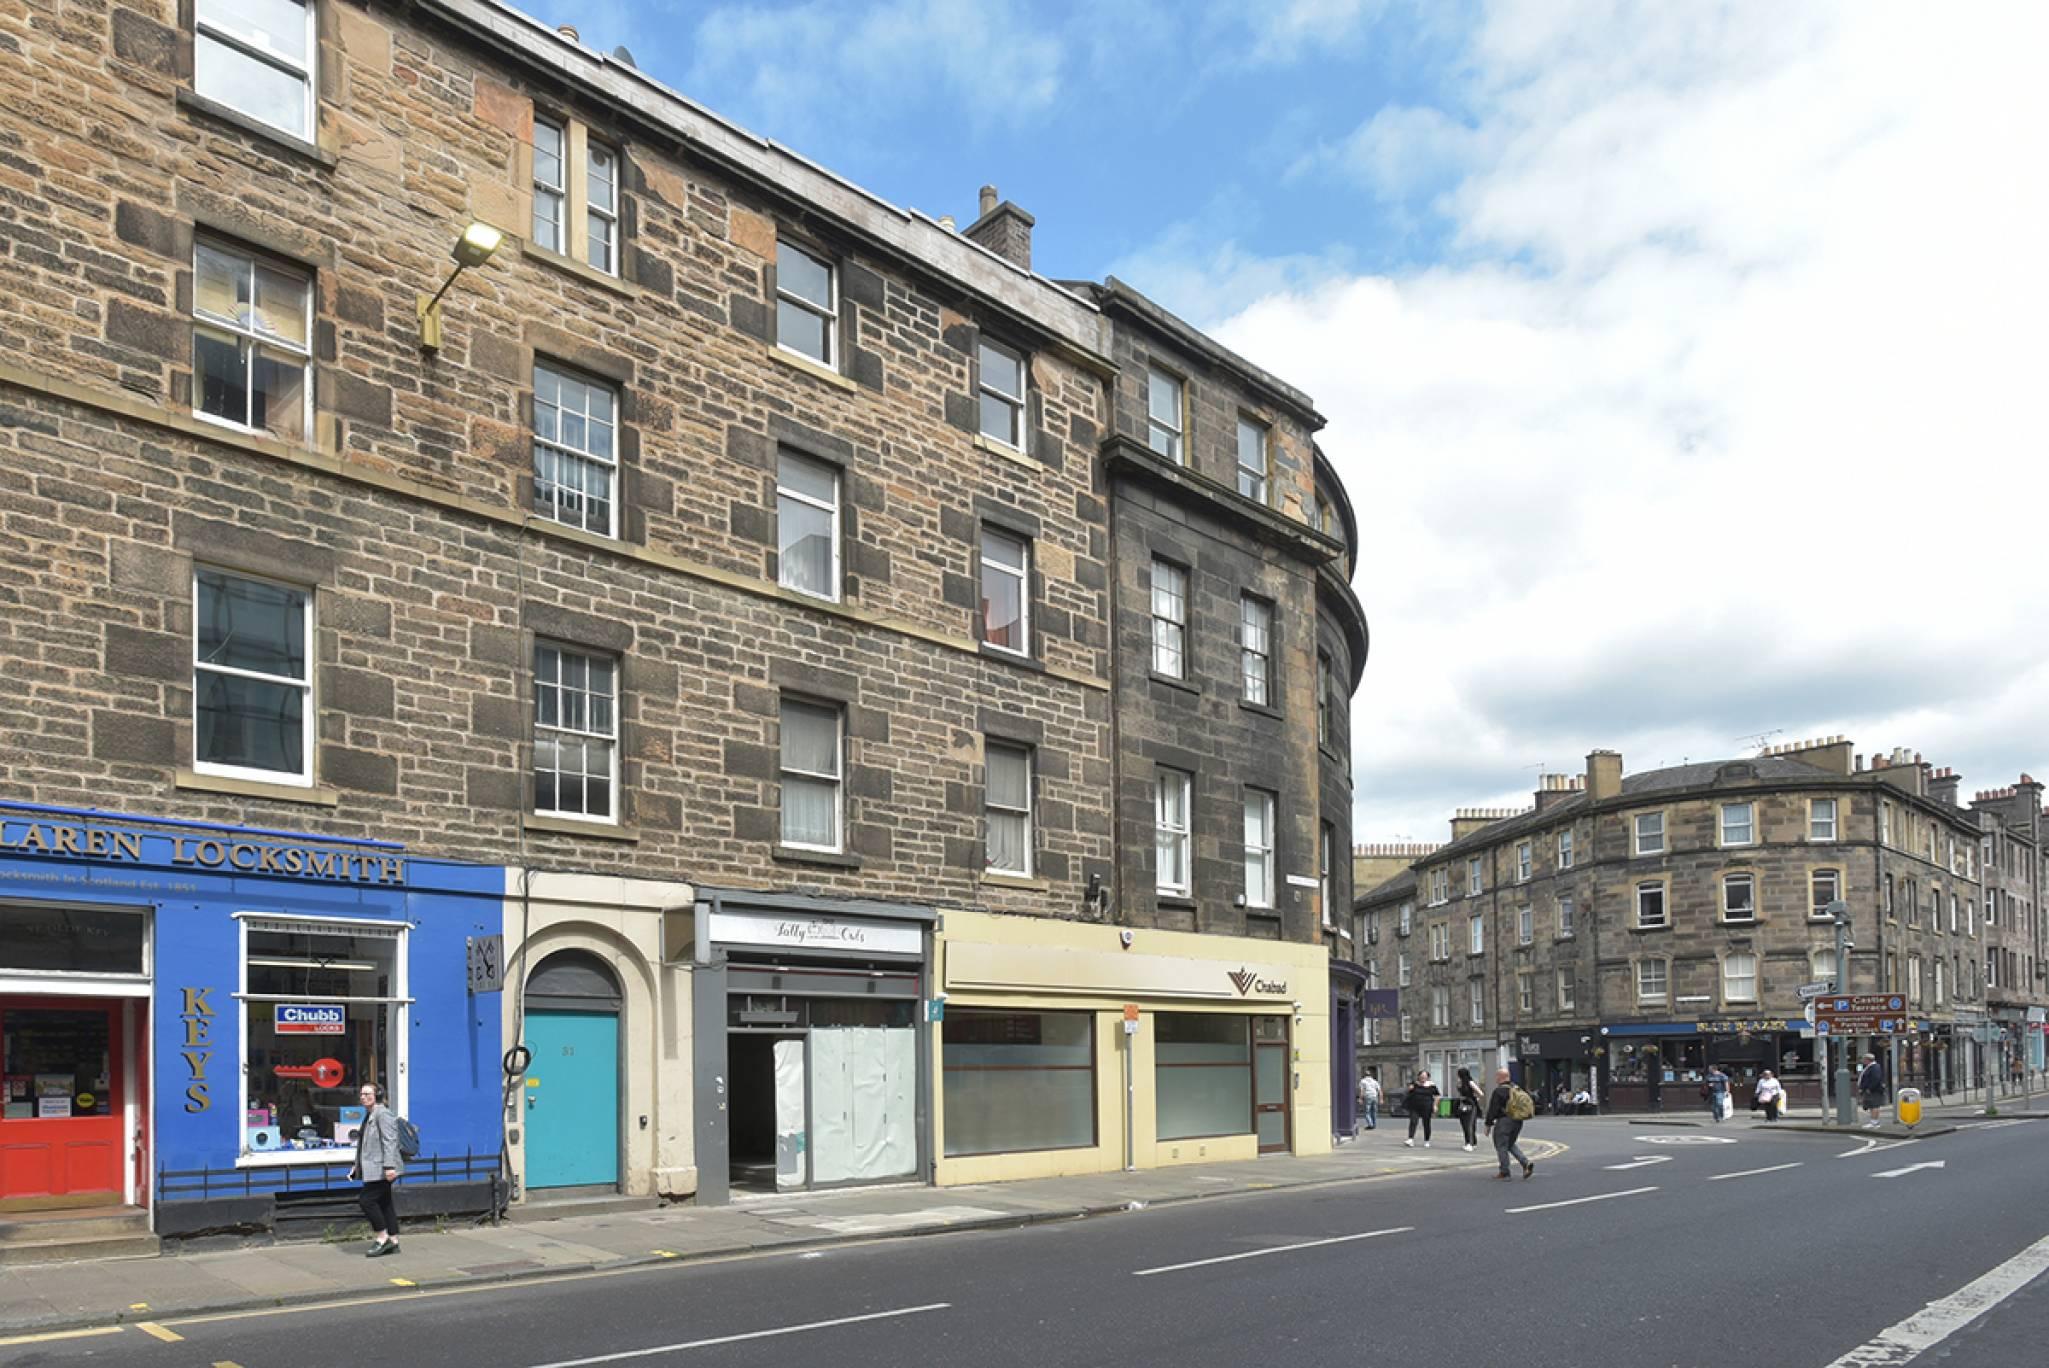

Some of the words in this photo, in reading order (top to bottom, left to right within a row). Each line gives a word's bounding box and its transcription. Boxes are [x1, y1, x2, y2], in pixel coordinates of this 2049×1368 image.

[0, 820, 142, 861] LAREN
[172, 837, 405, 885] LOCKSMITH
[284, 1008, 339, 1021] Chubb
[180, 986, 216, 1113] KEYS
